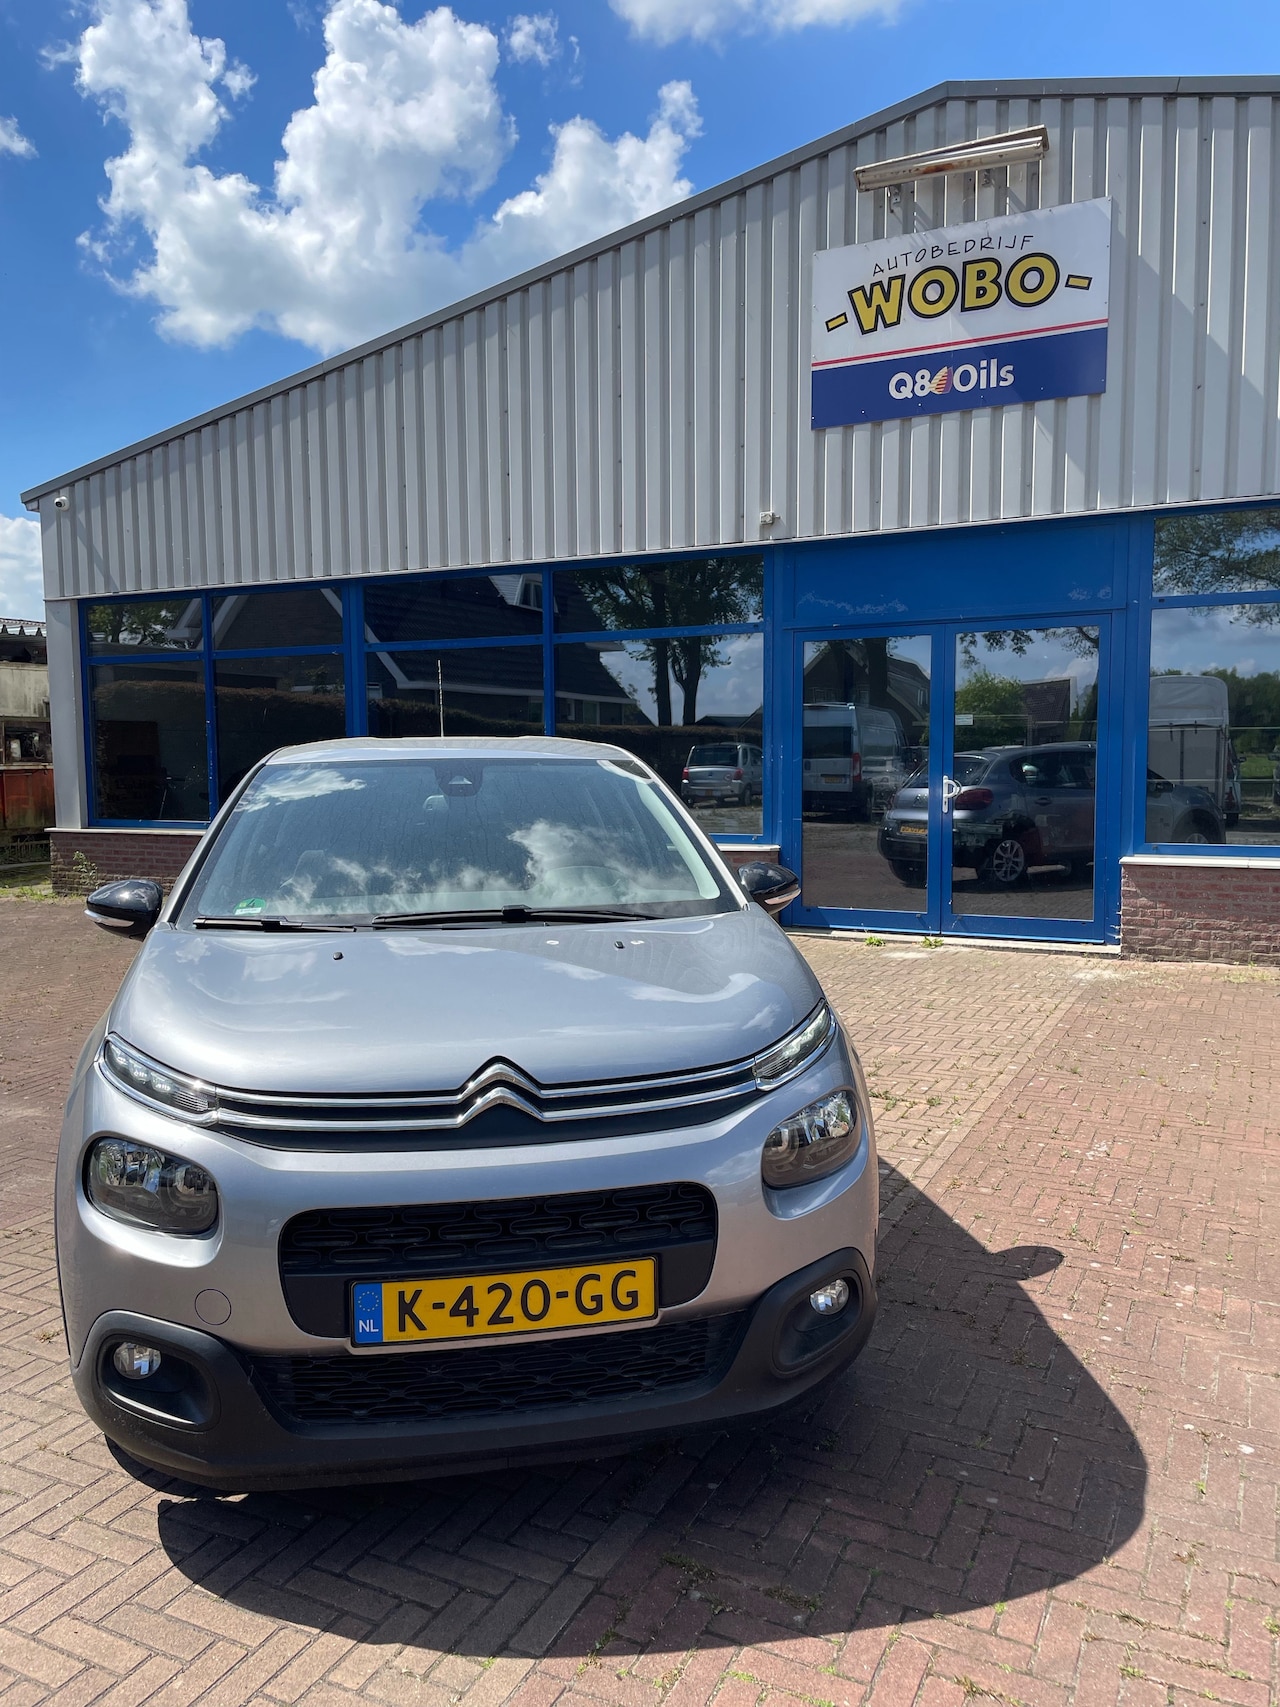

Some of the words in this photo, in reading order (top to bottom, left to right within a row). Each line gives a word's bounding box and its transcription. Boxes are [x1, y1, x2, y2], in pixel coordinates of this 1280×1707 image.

[873, 235, 1033, 277] AUTOBEDRIJF
[889, 369, 931, 400] Q8
[953, 359, 1014, 390] Oils
[398, 1270, 639, 1332] K-420-GG
[359, 1319, 379, 1332] NL
